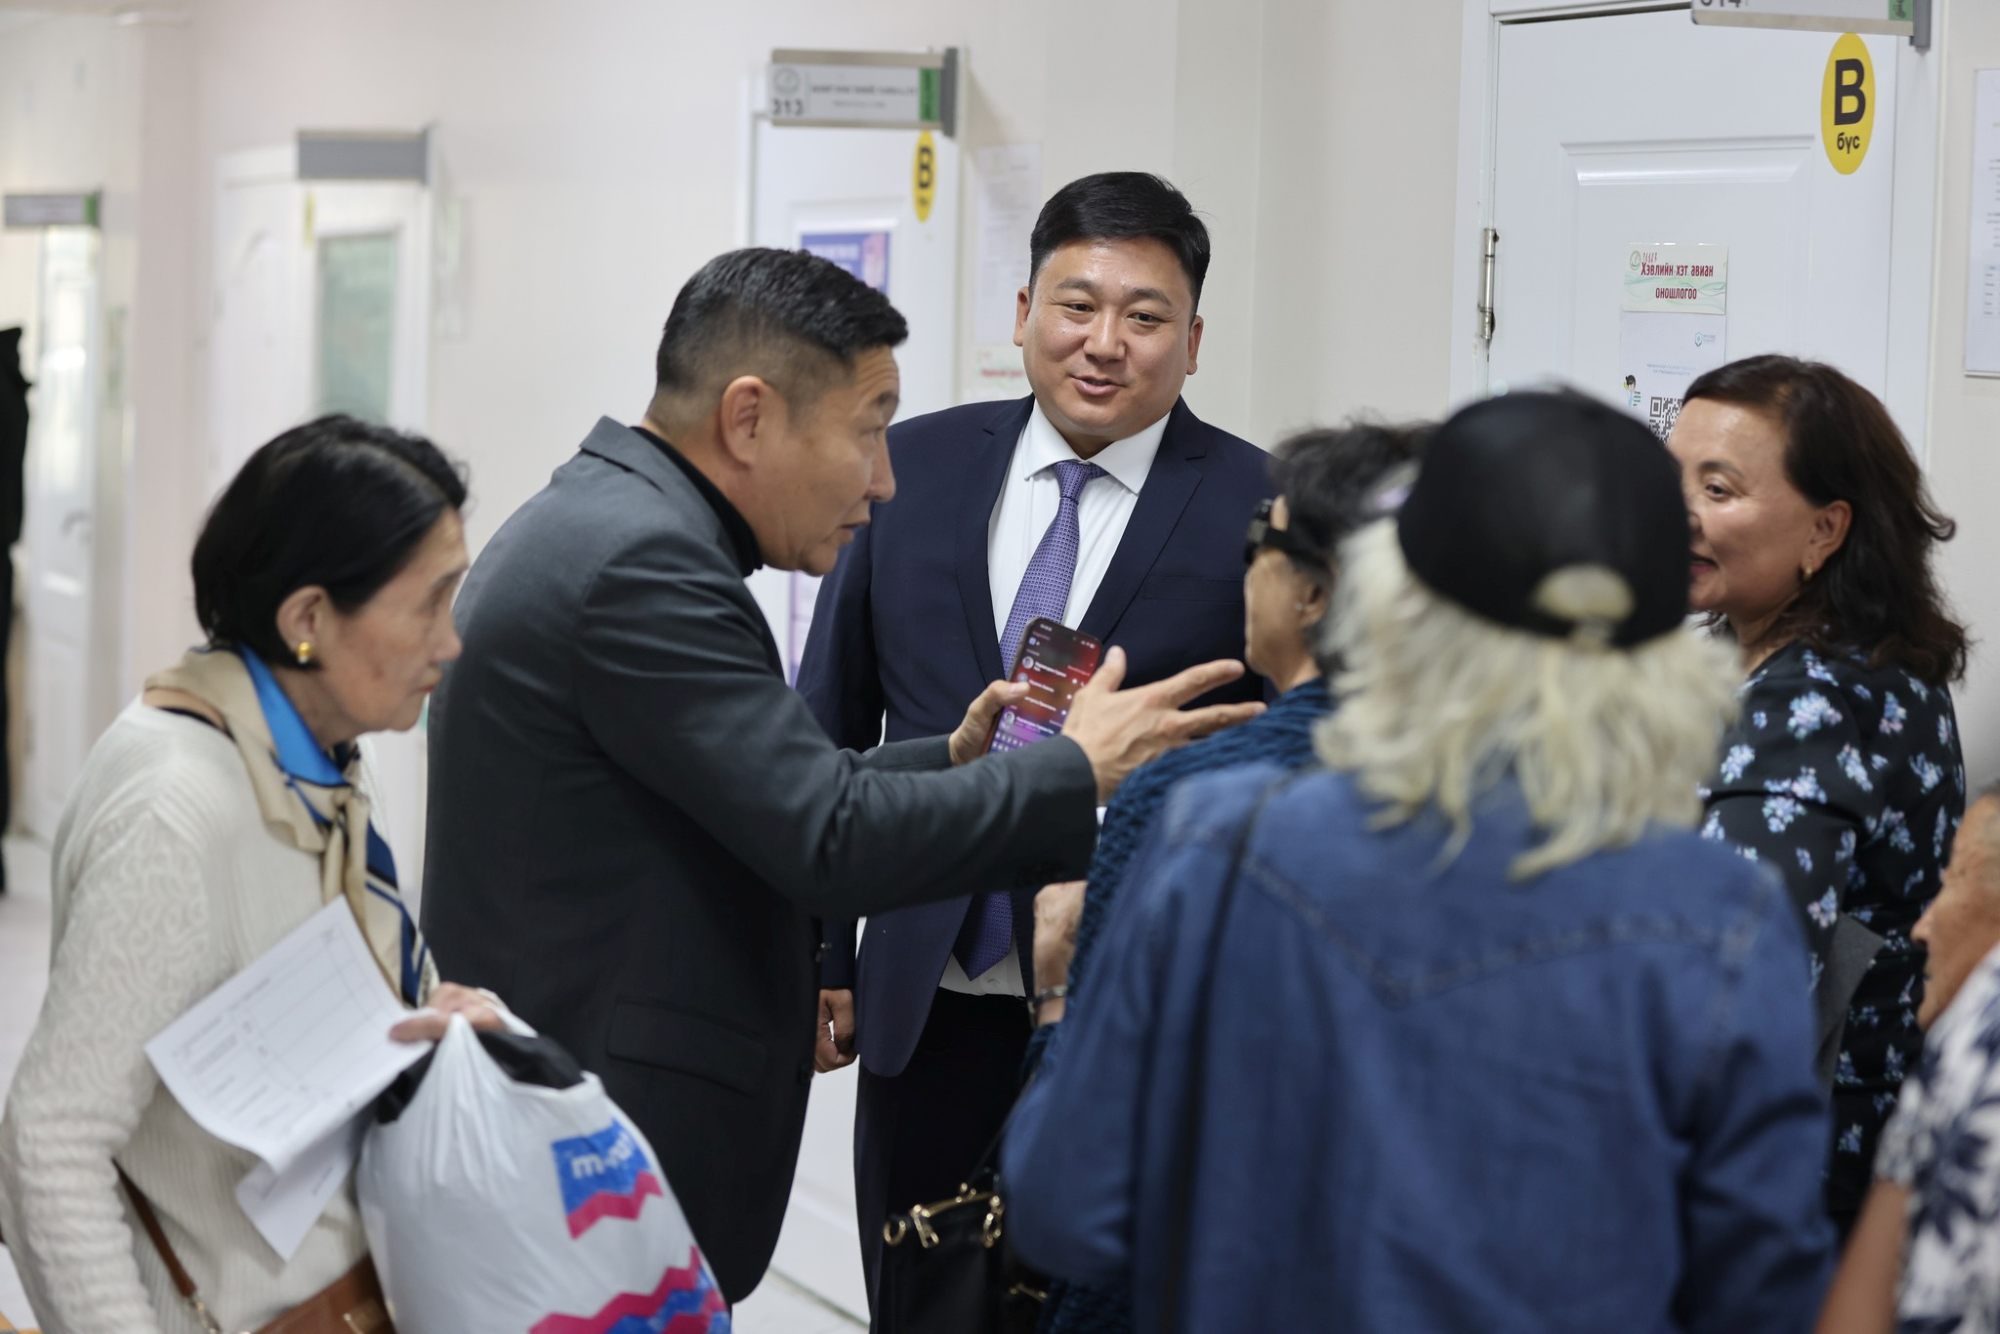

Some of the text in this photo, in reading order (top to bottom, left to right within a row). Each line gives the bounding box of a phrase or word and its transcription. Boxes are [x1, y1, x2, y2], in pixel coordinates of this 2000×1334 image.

[1834, 58, 1866, 125] В
[1837, 132, 1860, 154] бүс
[1641, 262, 1714, 277] Хэвлийн хэт авиан
[1656, 288, 1697, 299] оношлогоо
